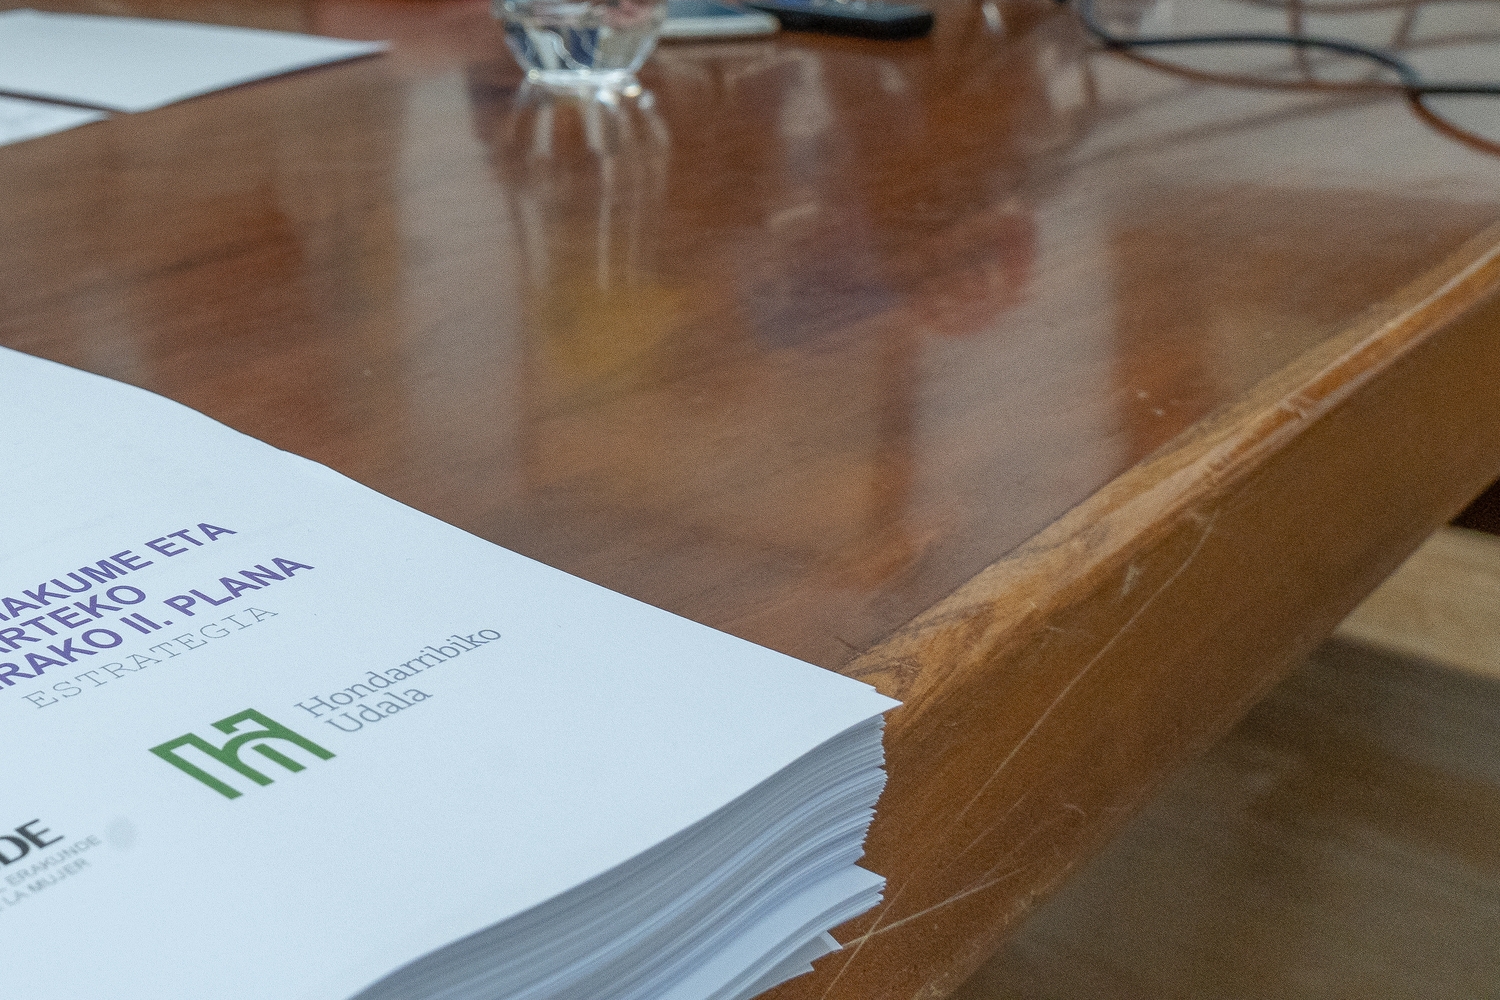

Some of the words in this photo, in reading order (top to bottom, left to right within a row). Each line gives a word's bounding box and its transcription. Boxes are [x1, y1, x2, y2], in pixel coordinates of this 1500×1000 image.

[145, 521, 237, 557] ETA
[119, 612, 173, 635] II.
[162, 556, 315, 616] PLANA
[21, 605, 279, 709] ESTRATEGIA
[294, 628, 502, 718] Hondarribiko
[324, 688, 434, 733] Udala
[2, 889, 31, 907] LA
[26, 857, 92, 894] MUJER
